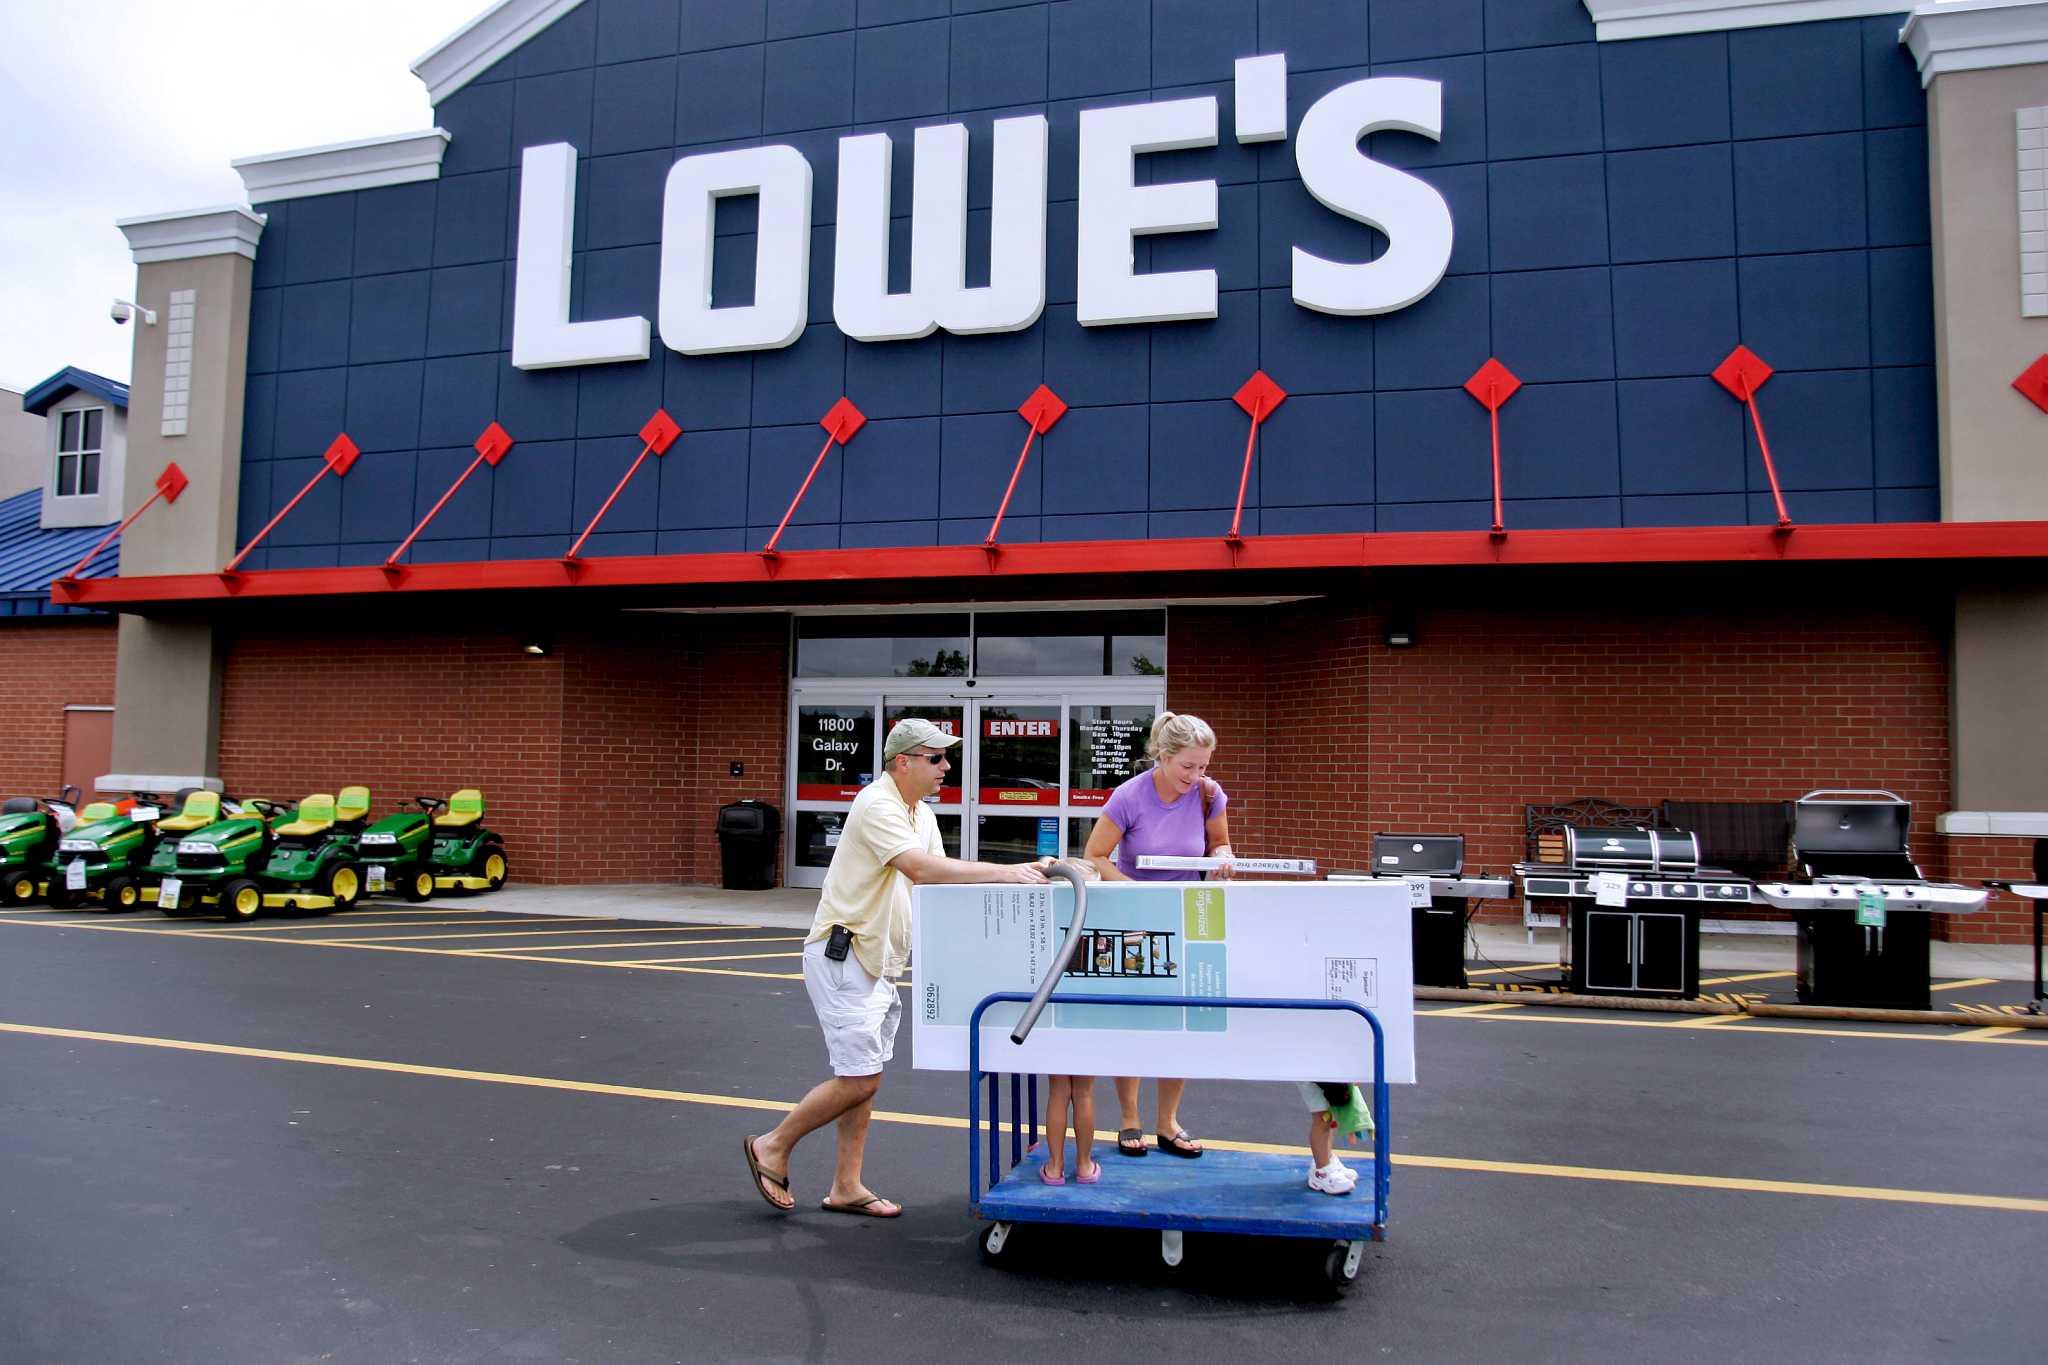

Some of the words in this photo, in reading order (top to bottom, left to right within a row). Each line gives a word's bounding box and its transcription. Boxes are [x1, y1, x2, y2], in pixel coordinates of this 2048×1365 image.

[512, 52, 1454, 370] LOWE'S
[817, 718, 855, 732] 11800
[990, 721, 1051, 736] ENTER
[812, 738, 859, 755] Galaxy
[825, 758, 845, 771] Dr.
